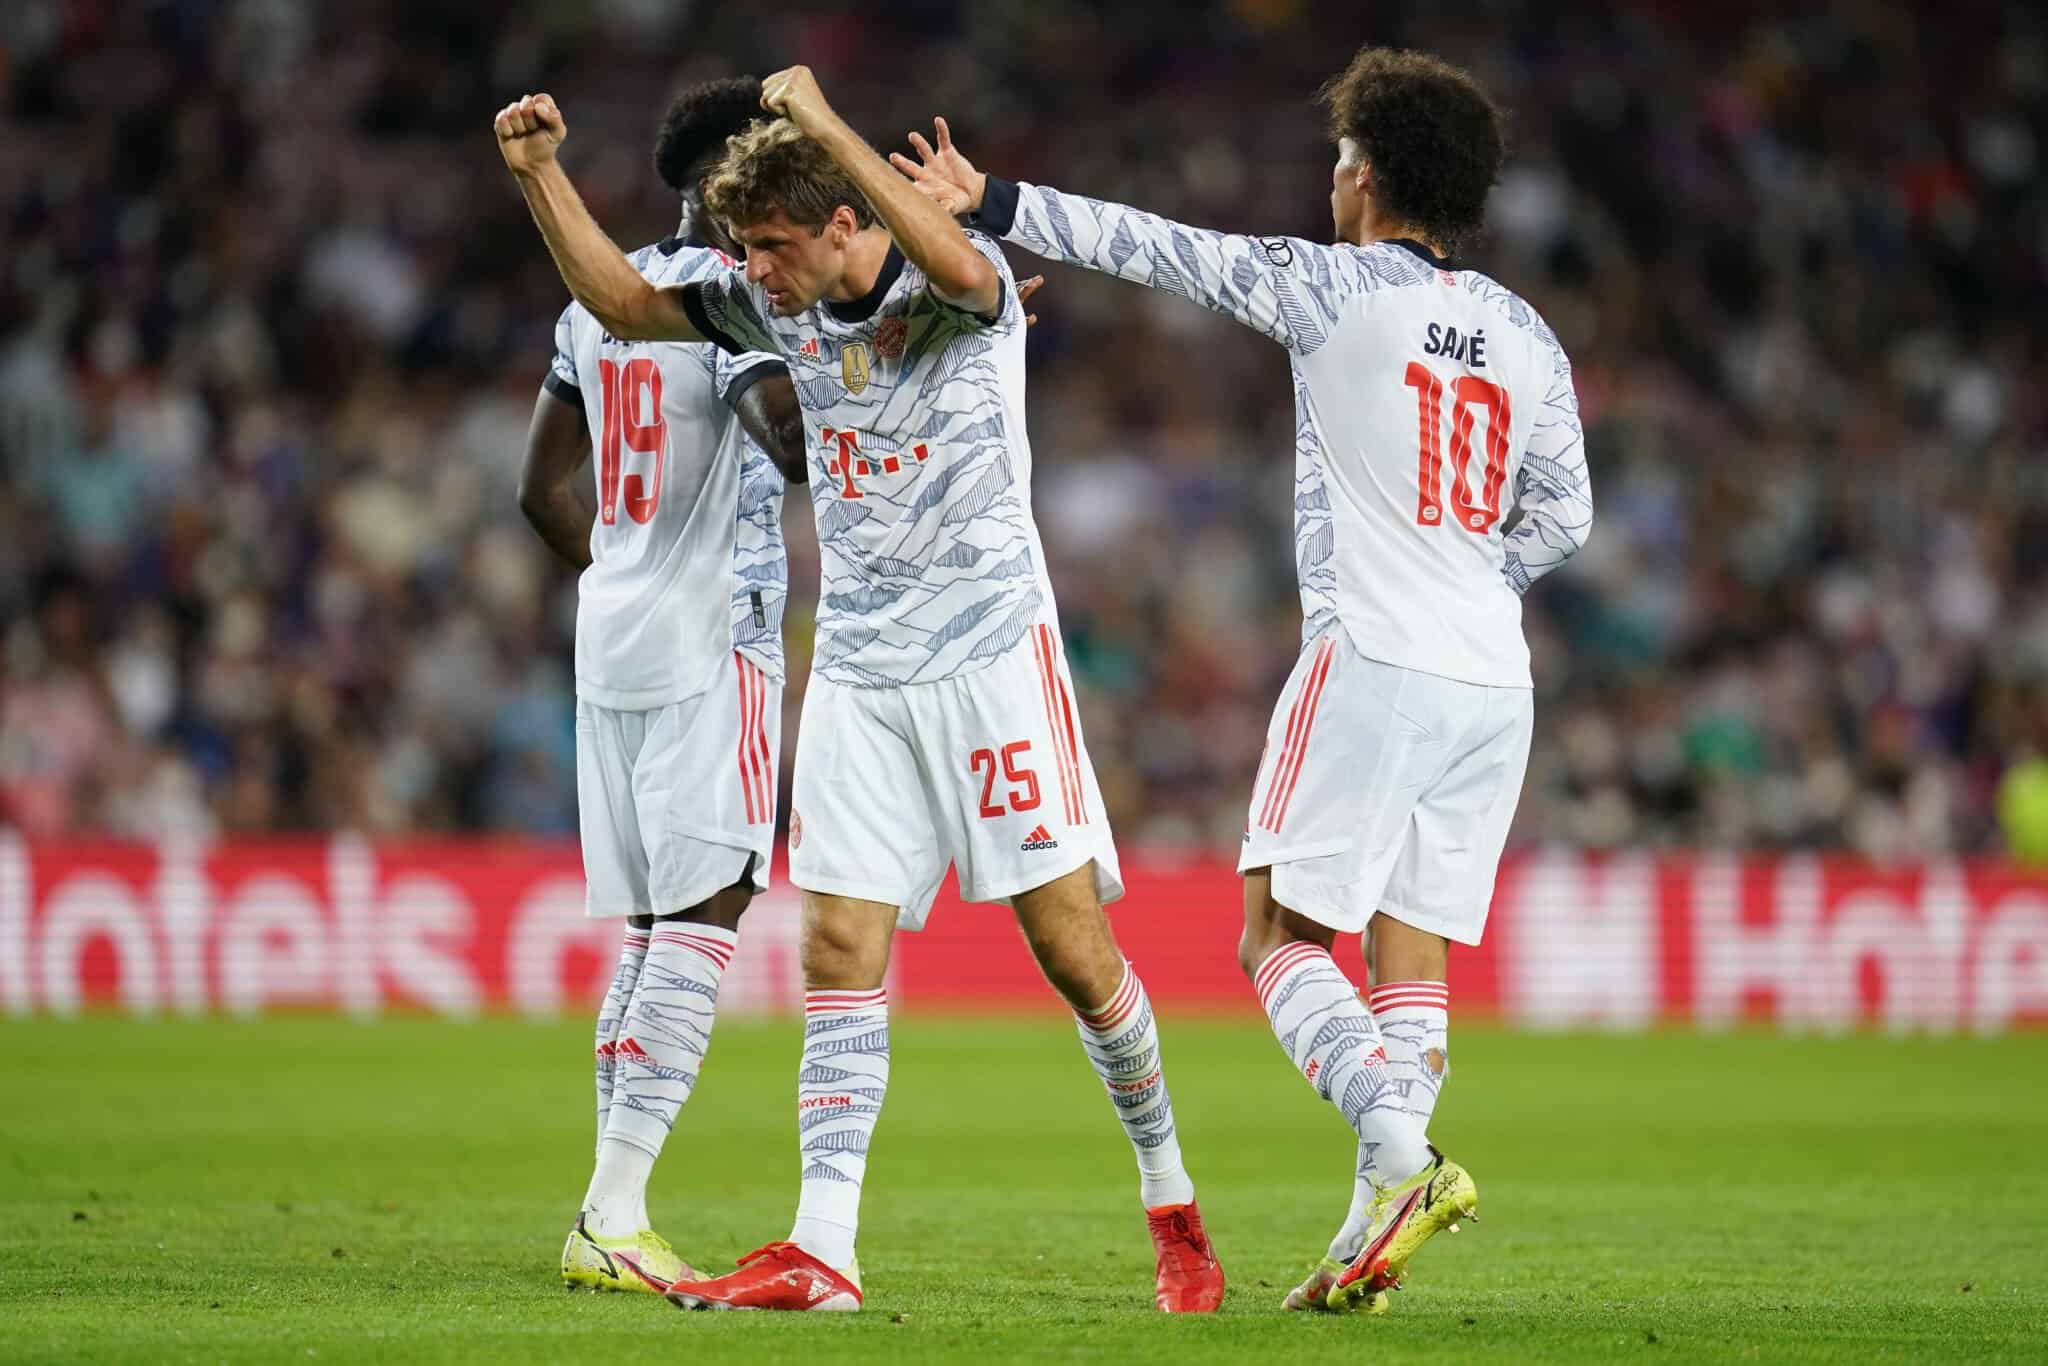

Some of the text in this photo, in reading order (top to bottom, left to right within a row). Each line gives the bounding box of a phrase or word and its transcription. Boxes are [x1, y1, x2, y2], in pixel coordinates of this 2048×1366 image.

[598, 357, 667, 526] 19
[1404, 361, 1511, 535] 10
[970, 740, 1041, 818] 25
[1020, 840, 1058, 851] adidas
[800, 1096, 850, 1109] AYERN
